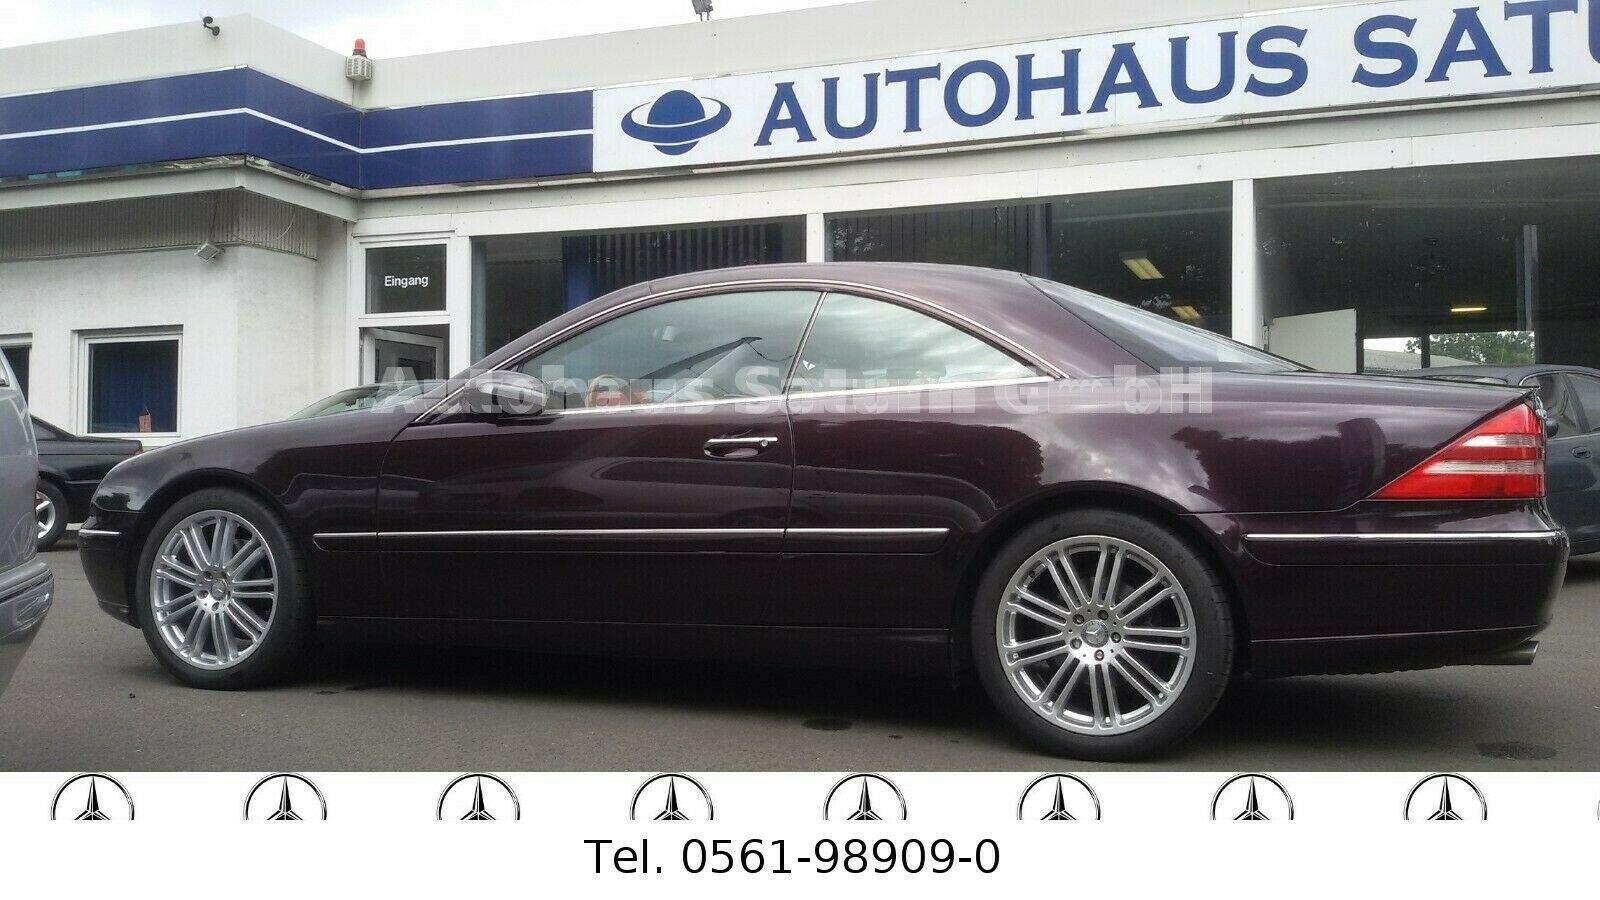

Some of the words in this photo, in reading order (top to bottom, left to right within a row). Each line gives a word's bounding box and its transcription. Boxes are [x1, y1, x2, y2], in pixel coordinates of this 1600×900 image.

[755, 26, 1309, 147] AUTOHAUS
[1351, 0, 1600, 88] SAT
[384, 274, 429, 289] Eingang
